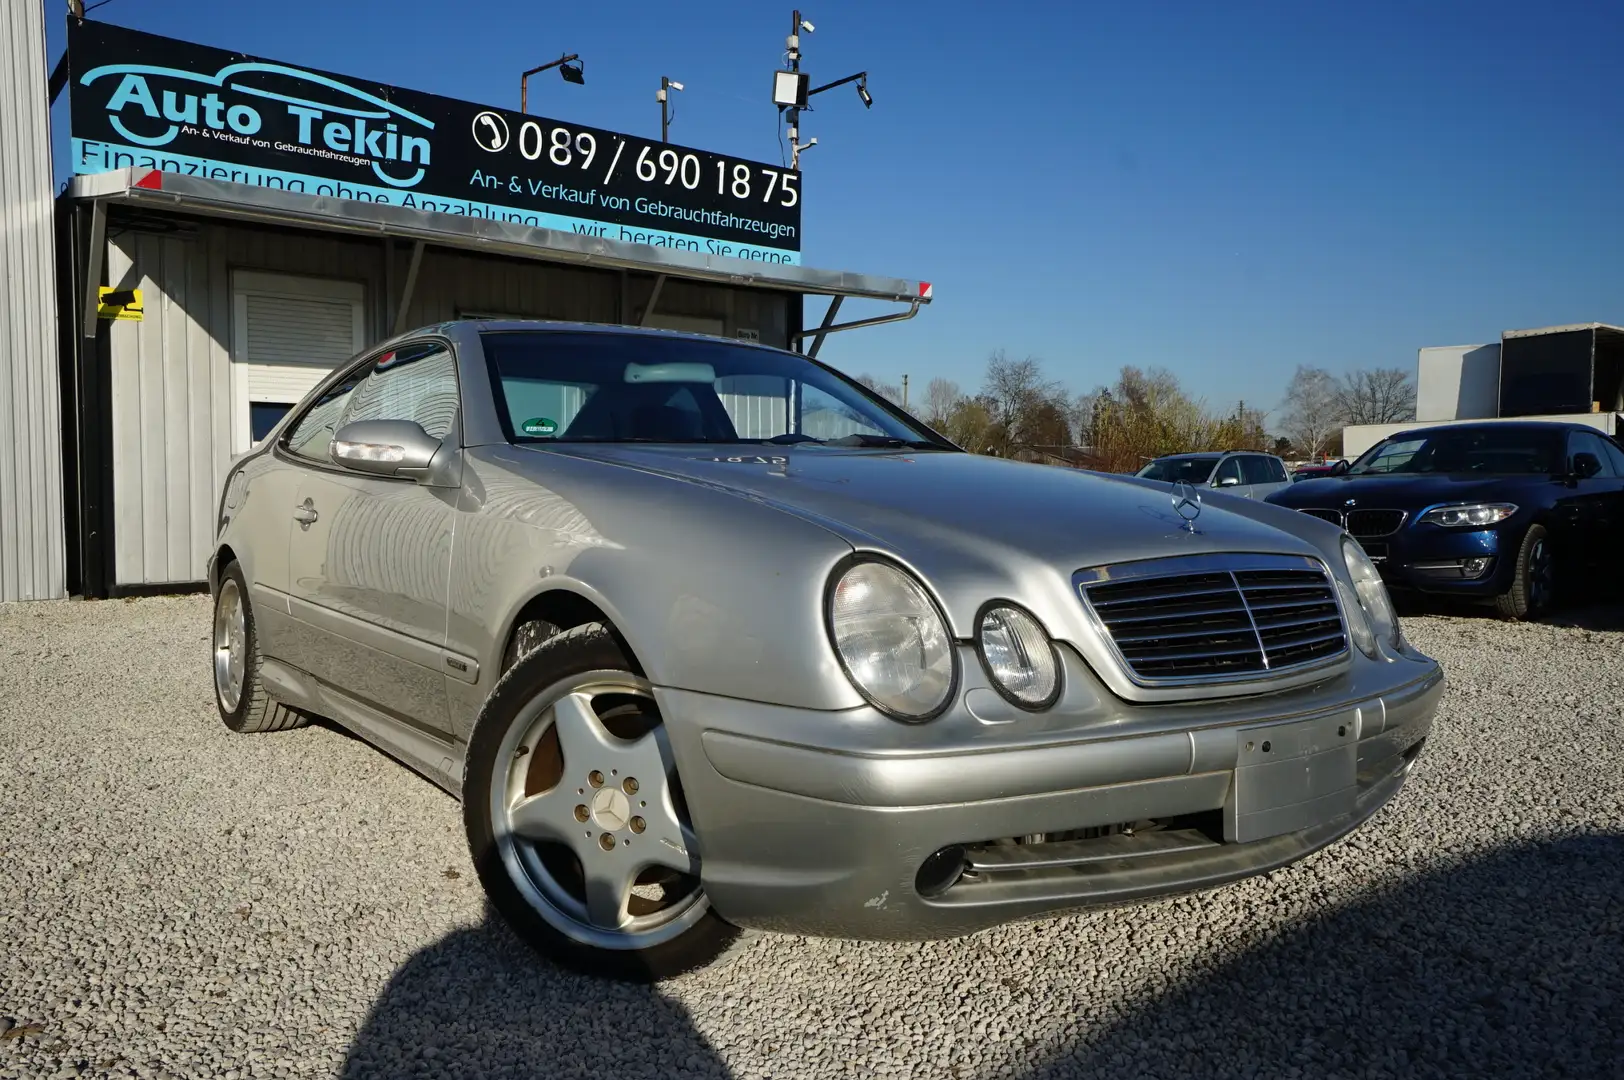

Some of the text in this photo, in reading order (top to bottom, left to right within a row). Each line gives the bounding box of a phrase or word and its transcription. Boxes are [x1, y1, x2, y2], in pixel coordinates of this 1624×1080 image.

[105, 74, 431, 166] Auto Tekin
[181, 125, 371, 166] An- & Verkauf von Gebrauchtfahrzeugen
[519, 121, 798, 208] 089 / 690 18 75
[469, 169, 795, 239] An- & Verkauf von Gebrauchtfahrzeugen
